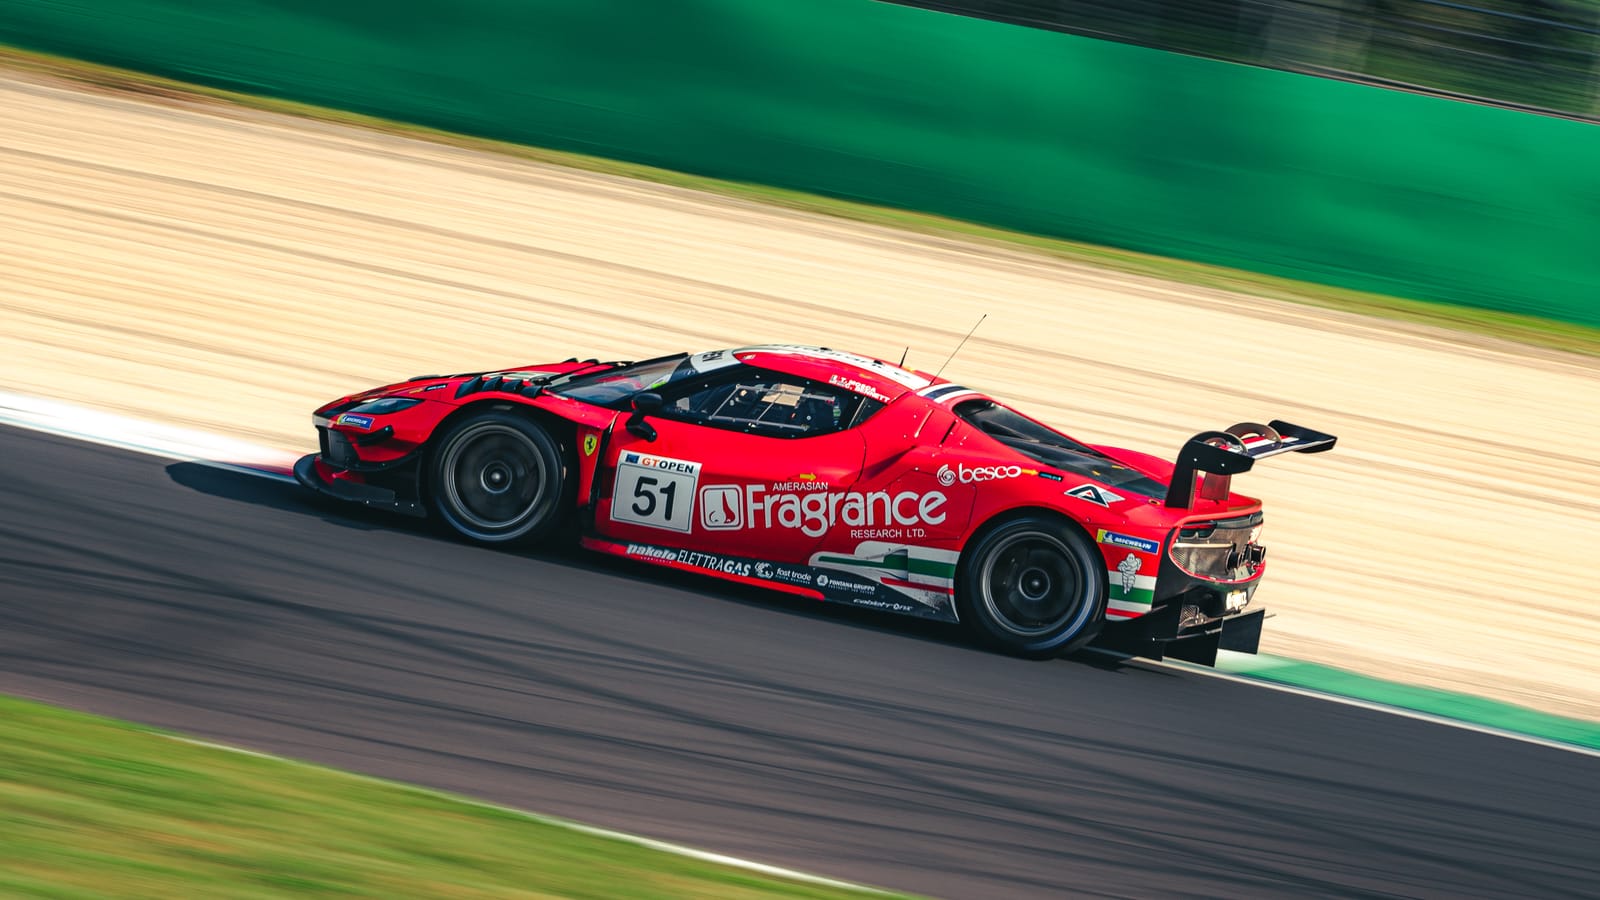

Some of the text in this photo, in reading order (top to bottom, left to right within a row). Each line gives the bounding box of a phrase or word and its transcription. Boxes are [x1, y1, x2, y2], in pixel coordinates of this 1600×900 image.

[958, 462, 1022, 484] besco
[772, 482, 829, 492] AMERASIAN
[631, 475, 677, 522] 51
[746, 484, 947, 538] Fragrance
[850, 528, 927, 539] RESEARCH LTD.
[1114, 537, 1152, 550] MICHELIN
[626, 543, 678, 561] pakelo
[776, 567, 791, 578] fast
[791, 570, 812, 581] trade
[829, 579, 853, 589] FONTANA
[853, 583, 876, 592] GRUPPO
